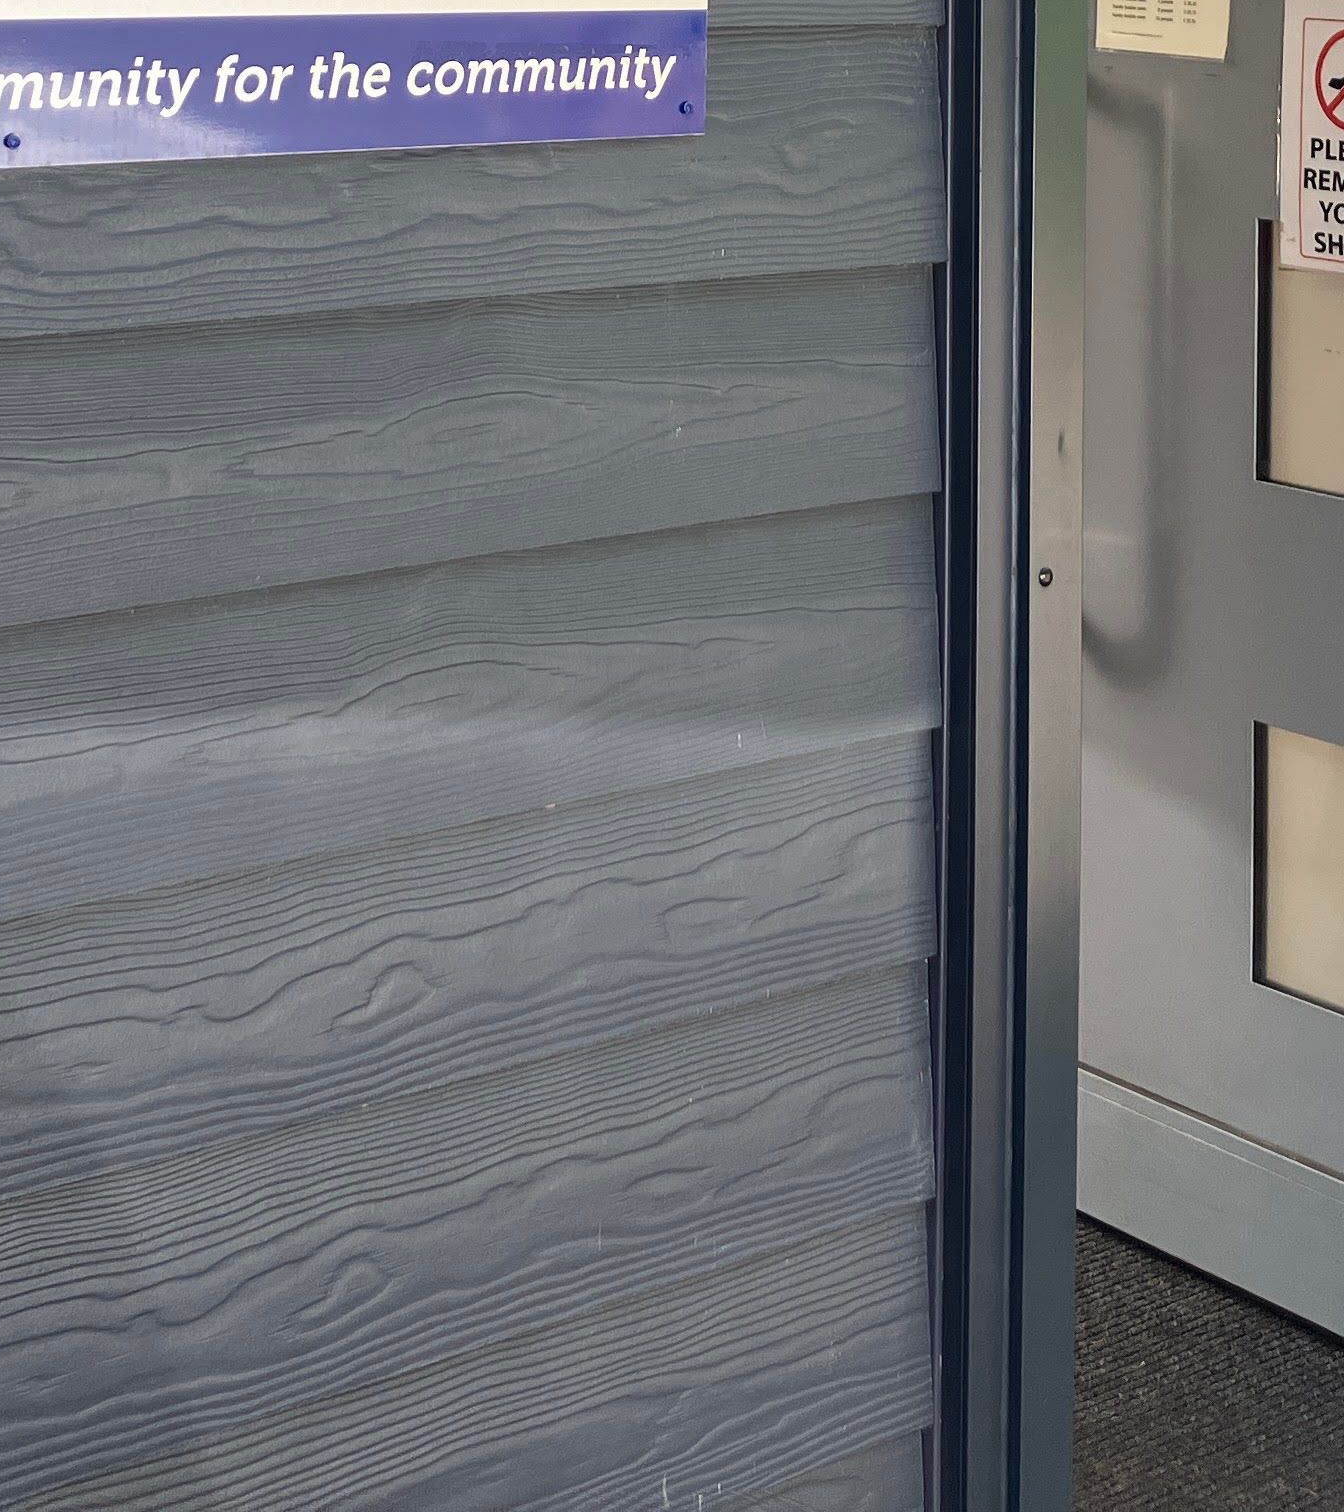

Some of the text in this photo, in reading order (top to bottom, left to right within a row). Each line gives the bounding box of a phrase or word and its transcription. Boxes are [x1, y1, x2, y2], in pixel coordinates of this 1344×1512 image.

[209, 54, 295, 105] for
[309, 51, 391, 100] the
[406, 44, 678, 100] community
